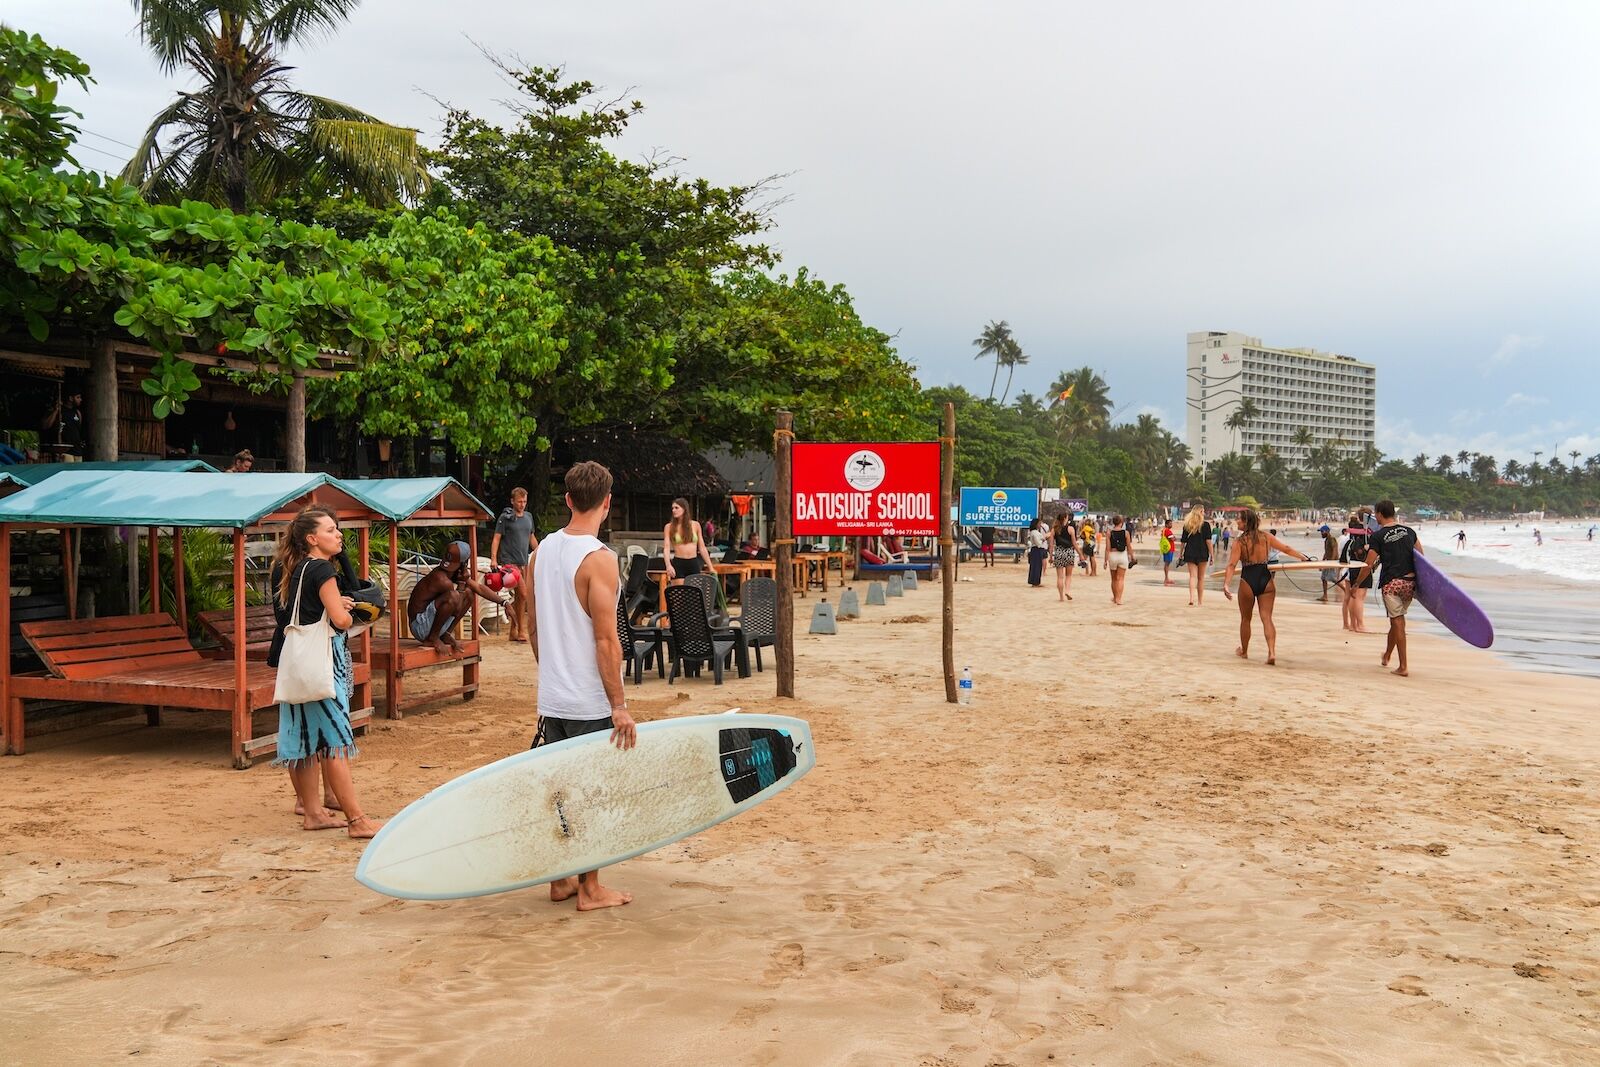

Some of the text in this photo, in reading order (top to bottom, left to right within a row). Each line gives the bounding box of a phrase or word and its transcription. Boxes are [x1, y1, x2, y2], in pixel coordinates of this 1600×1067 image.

[796, 492, 934, 520] BATUSURF SCHOOL
[977, 506, 1021, 514] FREEDOM
[993, 513, 1033, 521] SCHOOL
